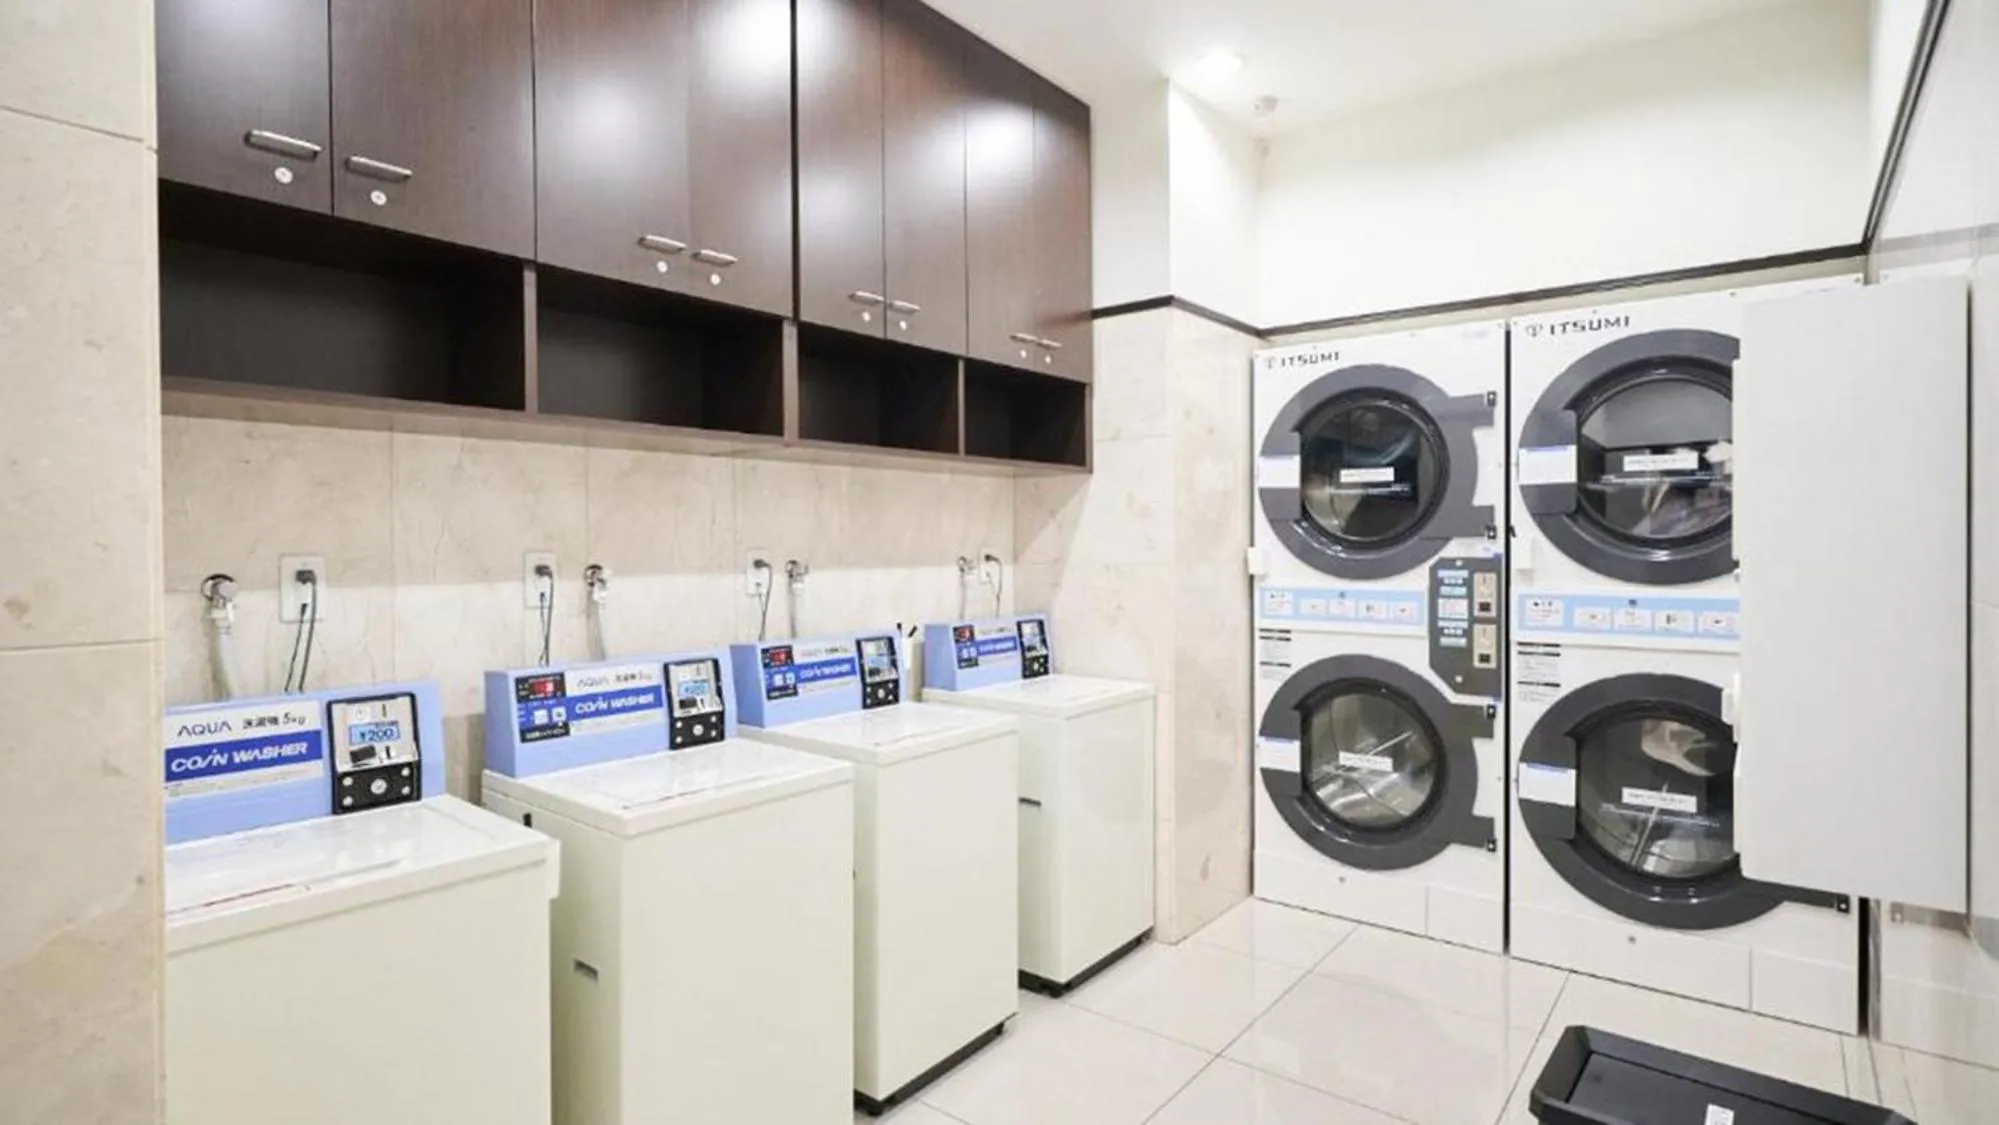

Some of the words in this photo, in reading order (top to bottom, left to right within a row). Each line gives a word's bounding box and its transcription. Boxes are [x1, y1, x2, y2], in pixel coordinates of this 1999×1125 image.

[1548, 315, 1630, 336] ITSUMI
[1281, 351, 1340, 367] ITSUMI
[575, 696, 608, 714] COIN
[177, 721, 232, 737] AQUA
[171, 749, 228, 773] COIN
[233, 742, 308, 764] WASHER
